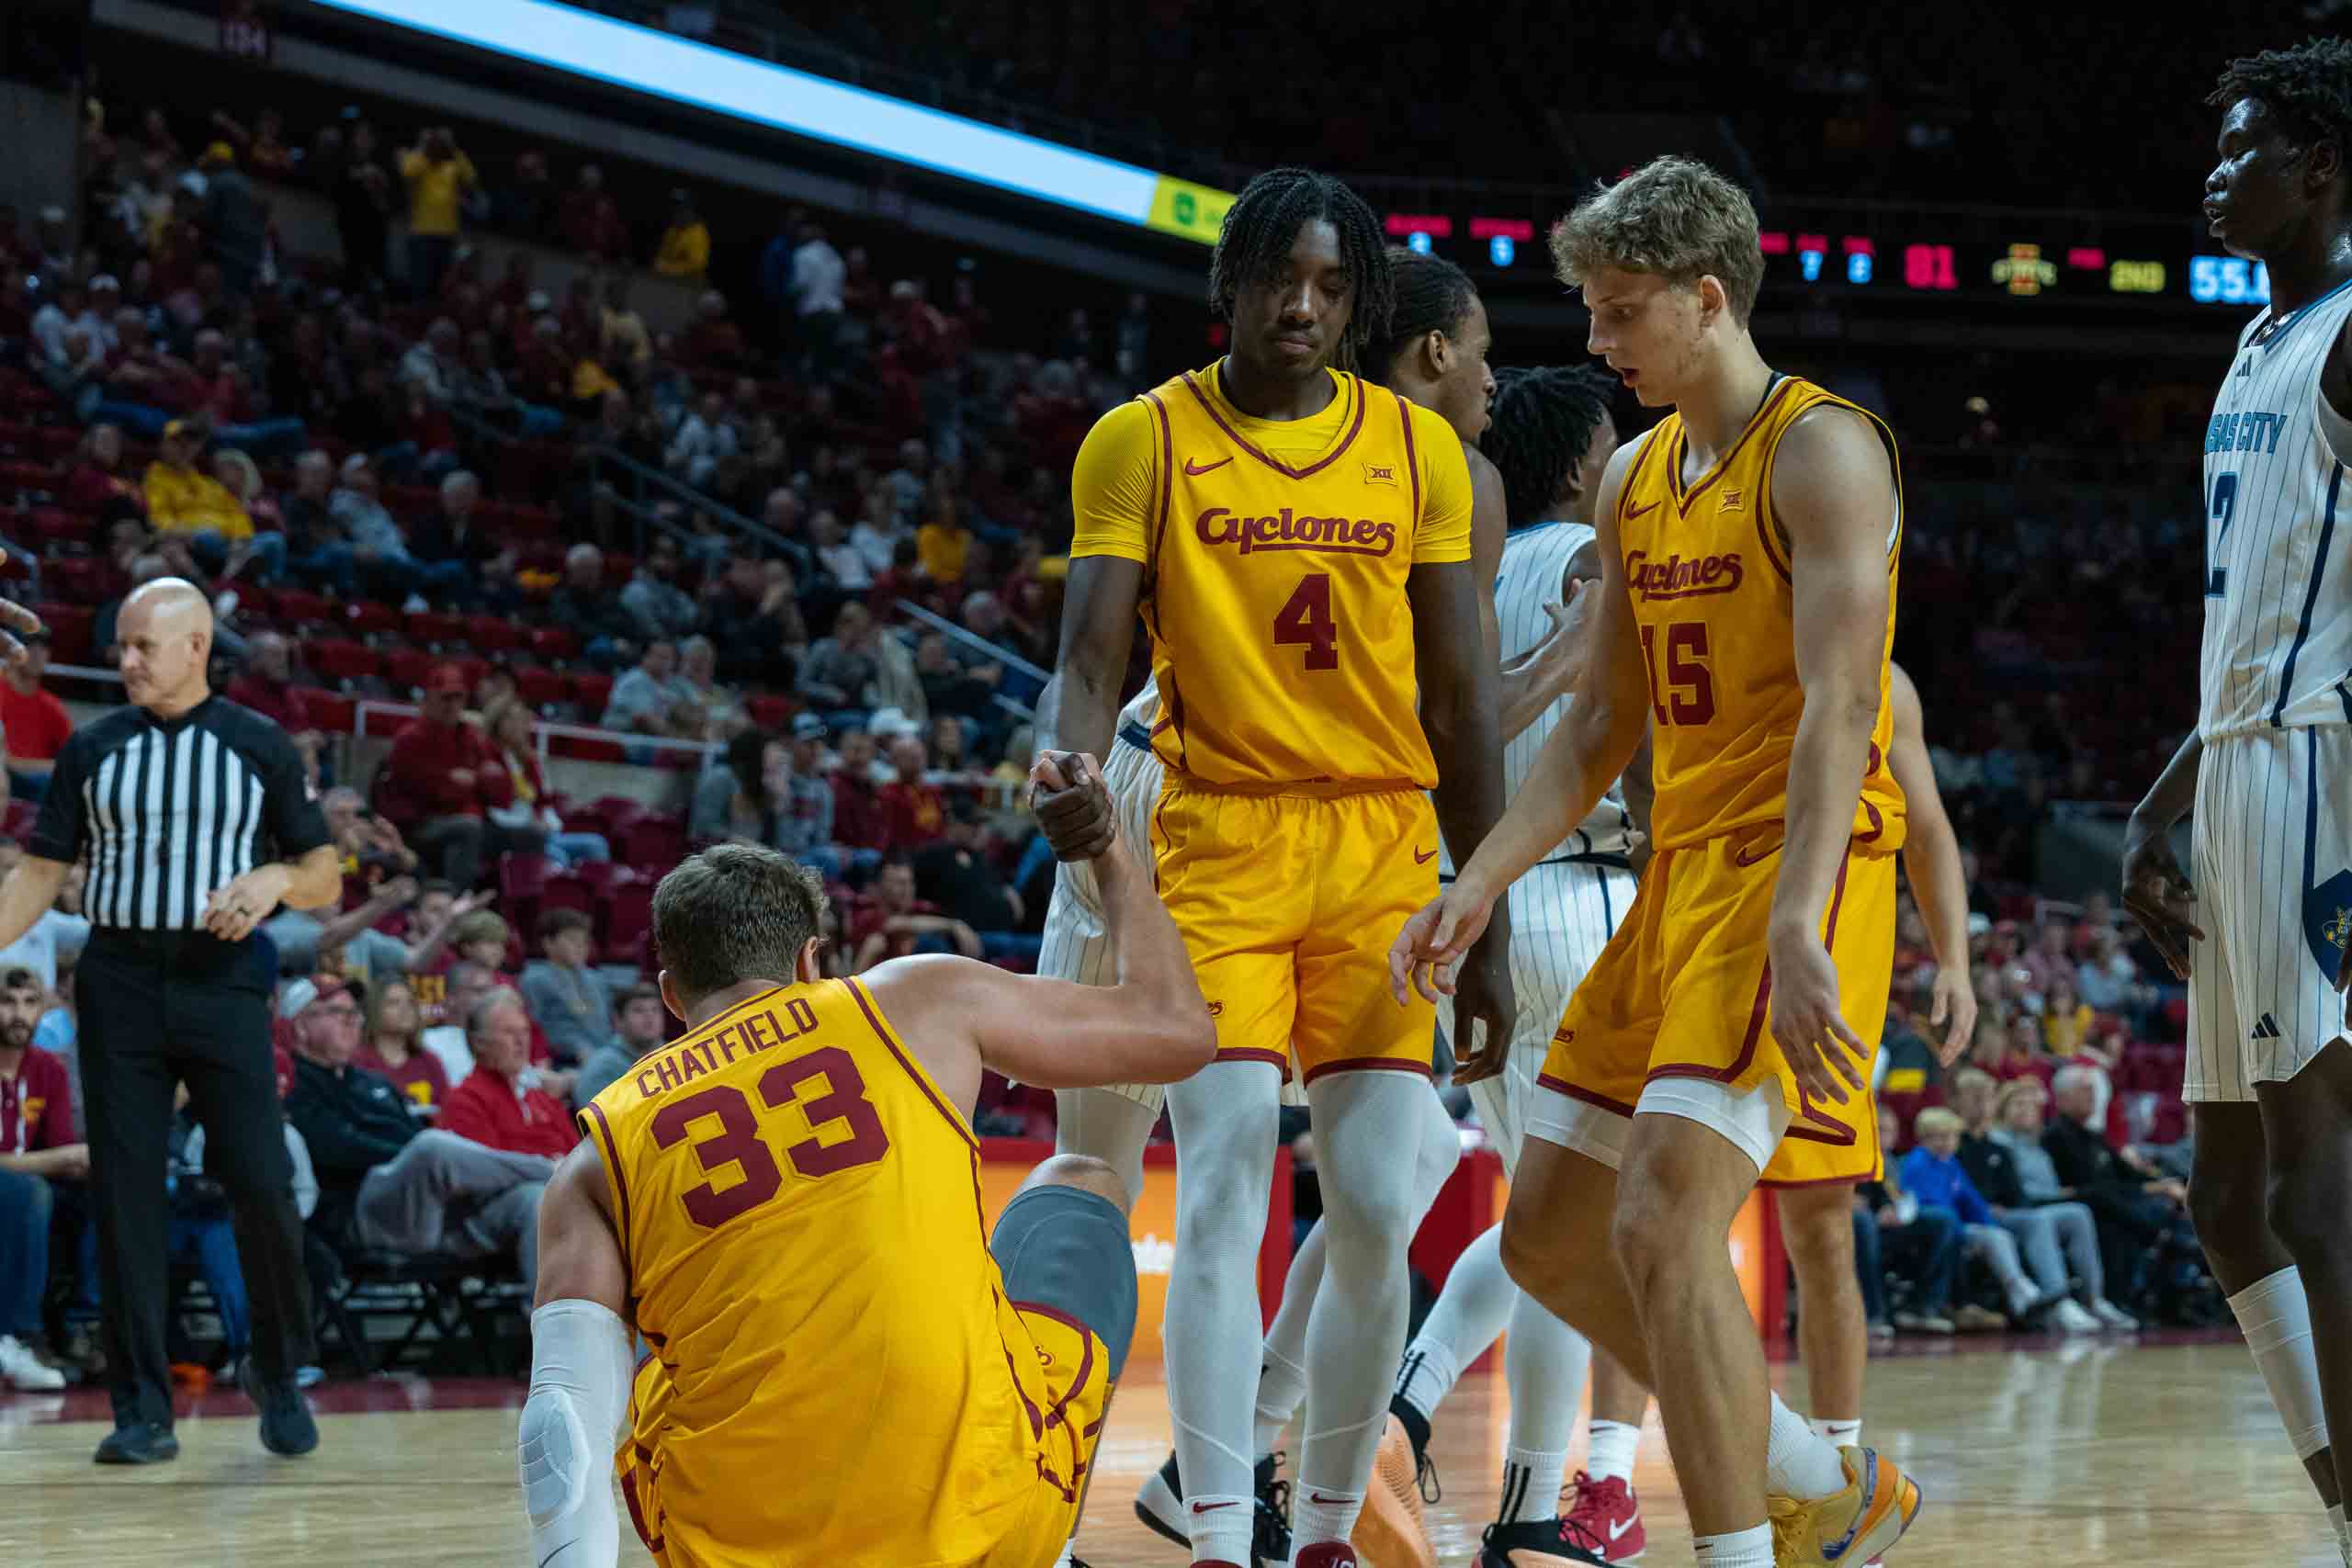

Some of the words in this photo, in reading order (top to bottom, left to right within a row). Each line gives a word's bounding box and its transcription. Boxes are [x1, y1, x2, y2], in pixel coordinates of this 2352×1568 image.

[2236, 412, 2288, 456] CITY
[1195, 507, 1396, 558] Cyclones
[1272, 572, 1340, 672] 4
[1640, 621, 1715, 728] 15
[636, 998, 820, 1099] CHATFIELD
[650, 1045, 891, 1230] 33
